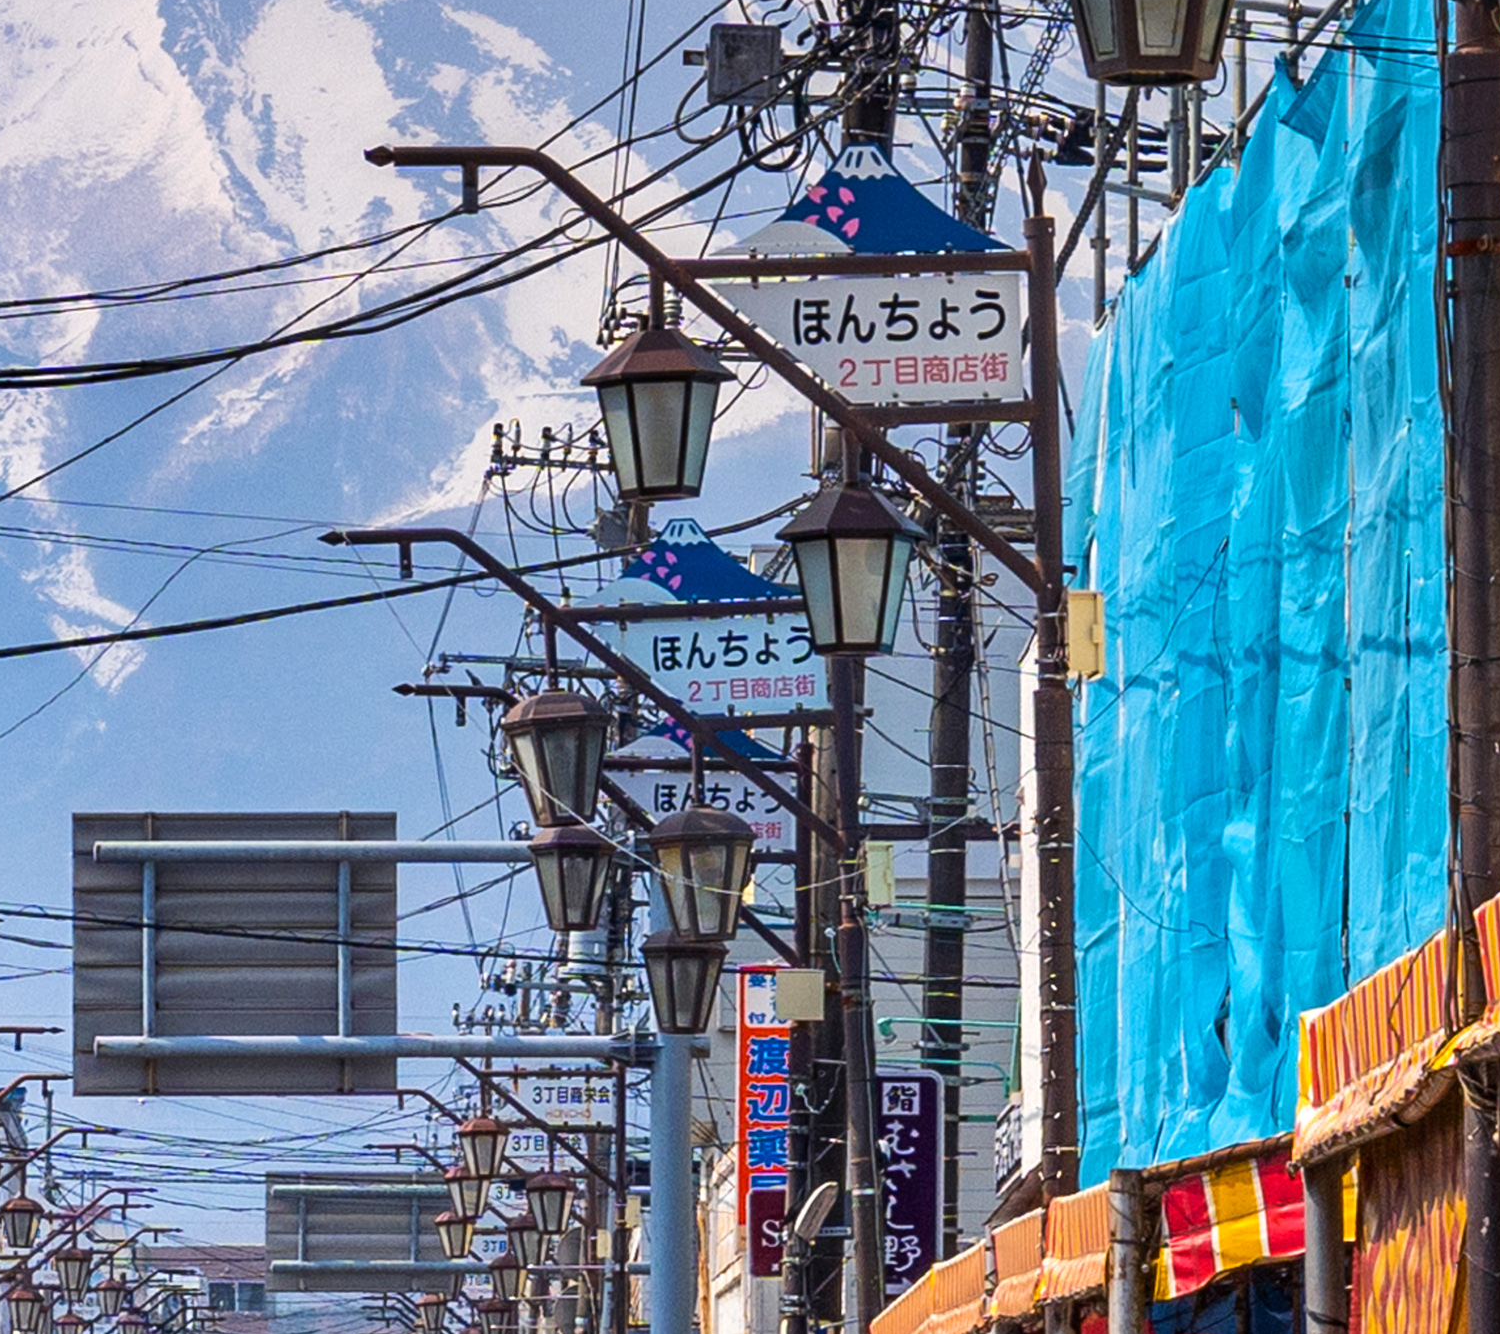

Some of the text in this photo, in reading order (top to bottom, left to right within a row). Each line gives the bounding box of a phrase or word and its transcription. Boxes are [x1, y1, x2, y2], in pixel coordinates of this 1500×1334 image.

[793, 288, 1007, 346] ほんちょう
[838, 352, 1010, 389] 2丁目商店街
[652, 626, 814, 673] ほんちょう
[687, 673, 816, 703] 2丁目商店街
